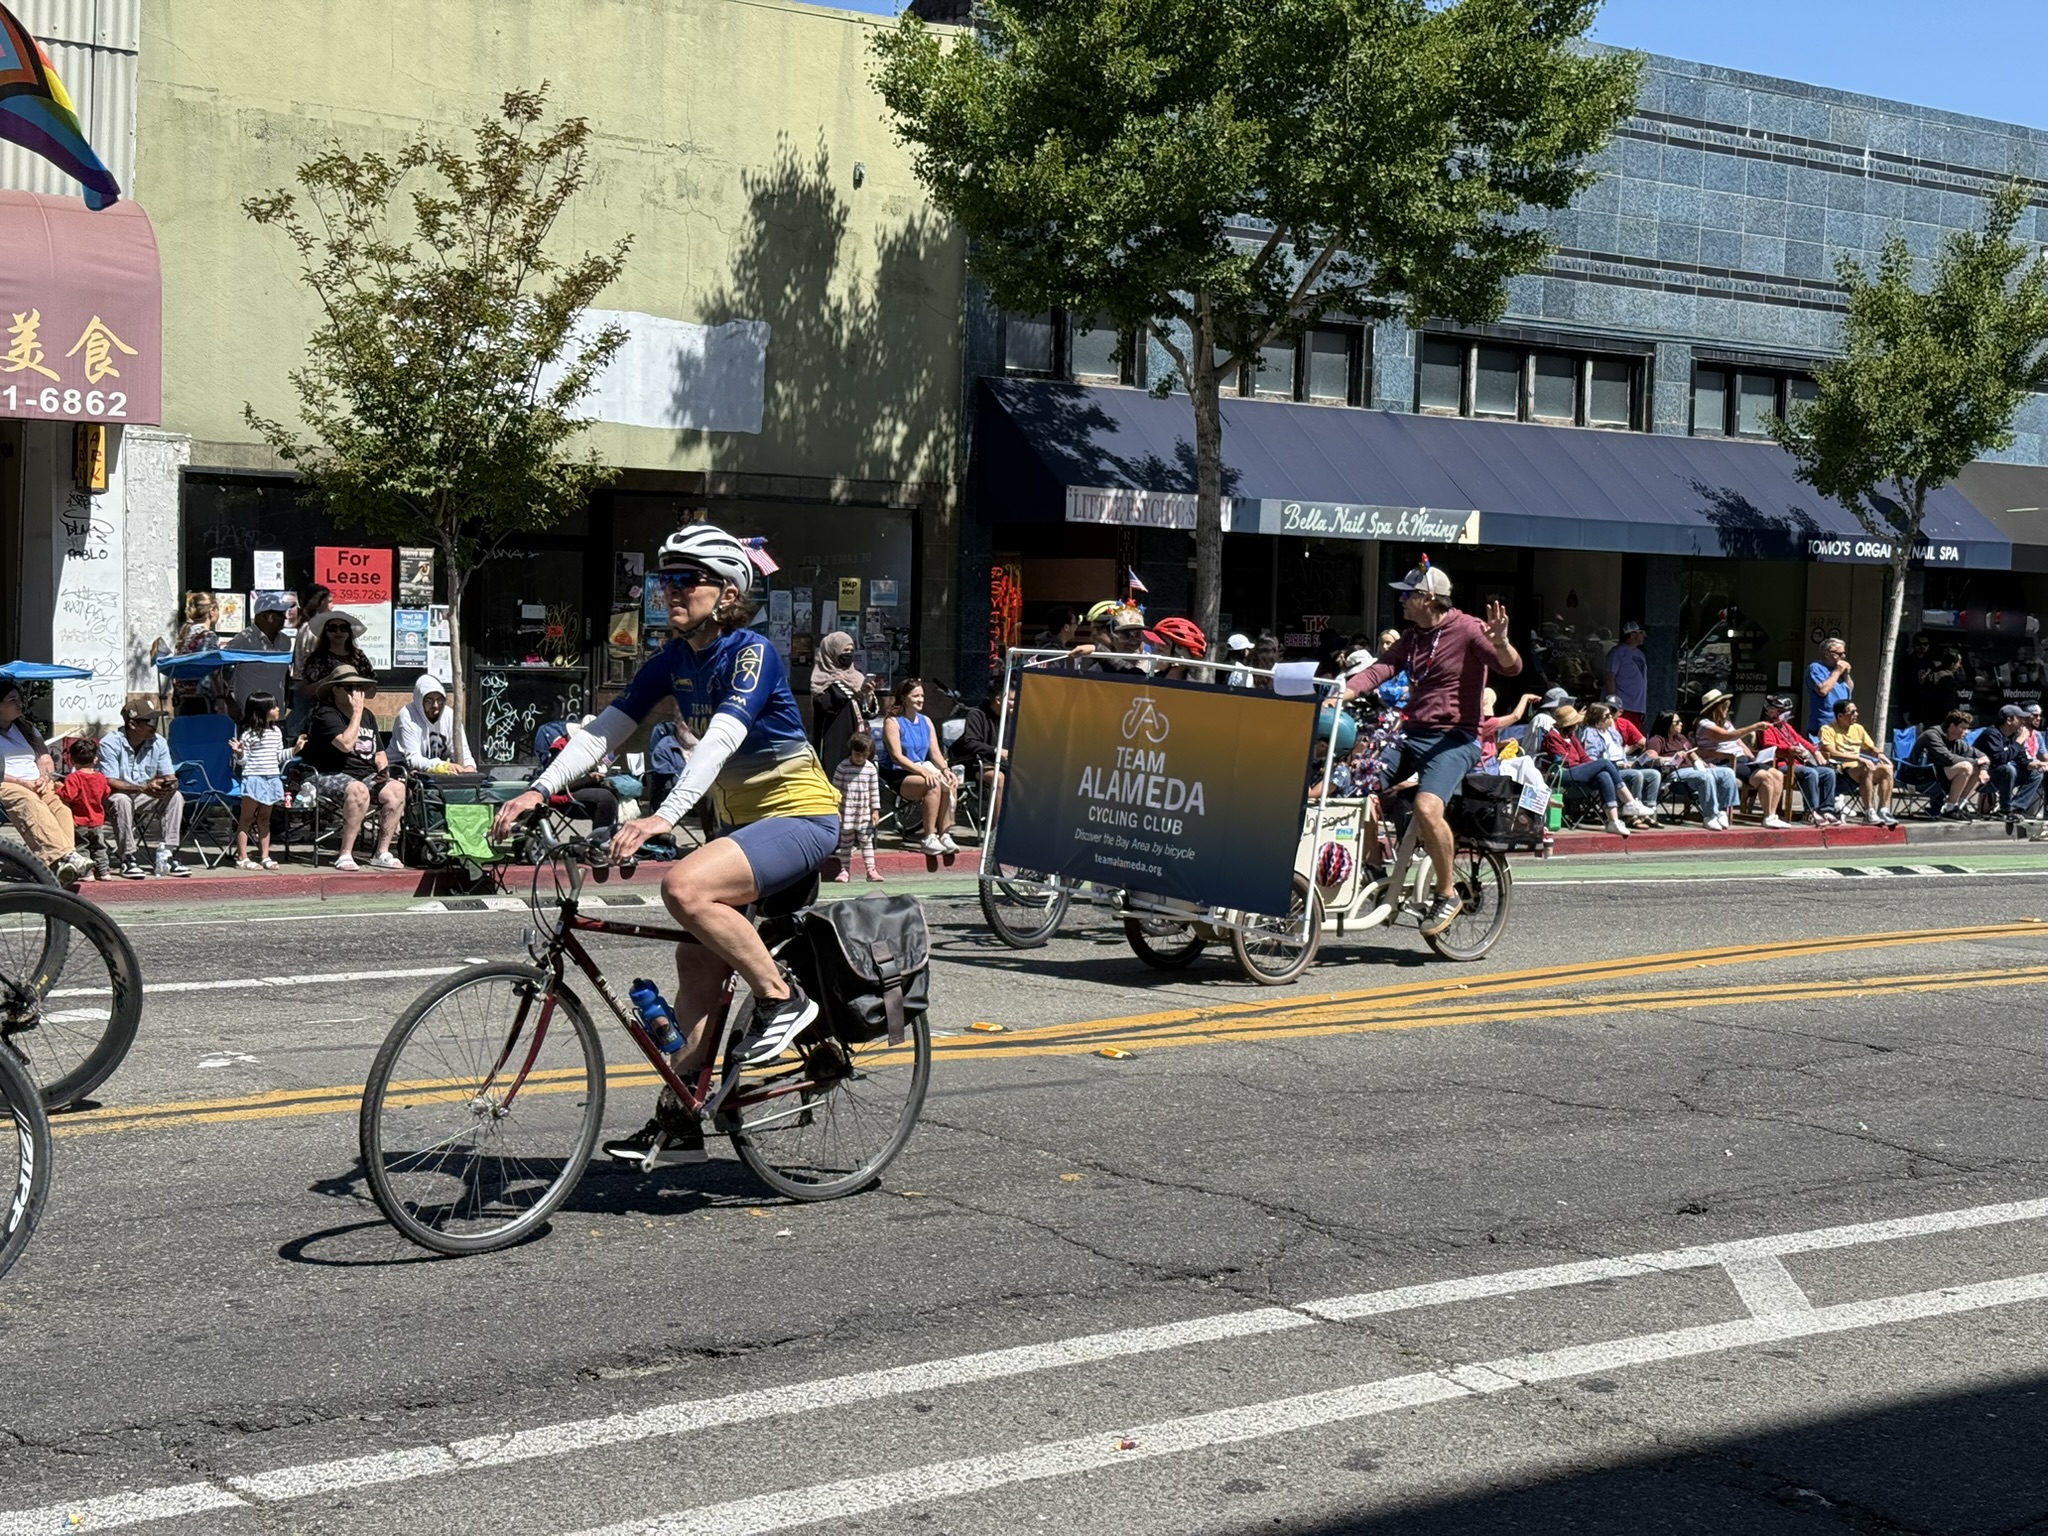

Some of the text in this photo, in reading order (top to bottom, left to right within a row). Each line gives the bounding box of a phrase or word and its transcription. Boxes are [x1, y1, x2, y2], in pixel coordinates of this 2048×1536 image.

[0, 308, 139, 385] 美食
[2, 385, 128, 417] 1-6862
[1072, 493, 1123, 520] LITTLE
[1283, 503, 1327, 531] Bella
[1328, 506, 1366, 534] Nail
[1367, 511, 1393, 539] Spa
[1396, 510, 1409, 536] &
[337, 550, 370, 566] For
[1807, 539, 1852, 557] TOMO'S
[1911, 544, 1936, 560] NAIL
[1938, 544, 1960, 561] SPA
[326, 567, 381, 585] Lease
[1302, 615, 1330, 633] TK
[2002, 688, 2042, 701] Wednesday
[1116, 746, 1166, 774] TEAM
[1077, 765, 1206, 816] ALAMEDA
[1088, 805, 1184, 836] CYCLING CLUB
[1074, 827, 1196, 860] Discover the Bay Area by bicycle
[1094, 853, 1163, 877] teamalameda.org
